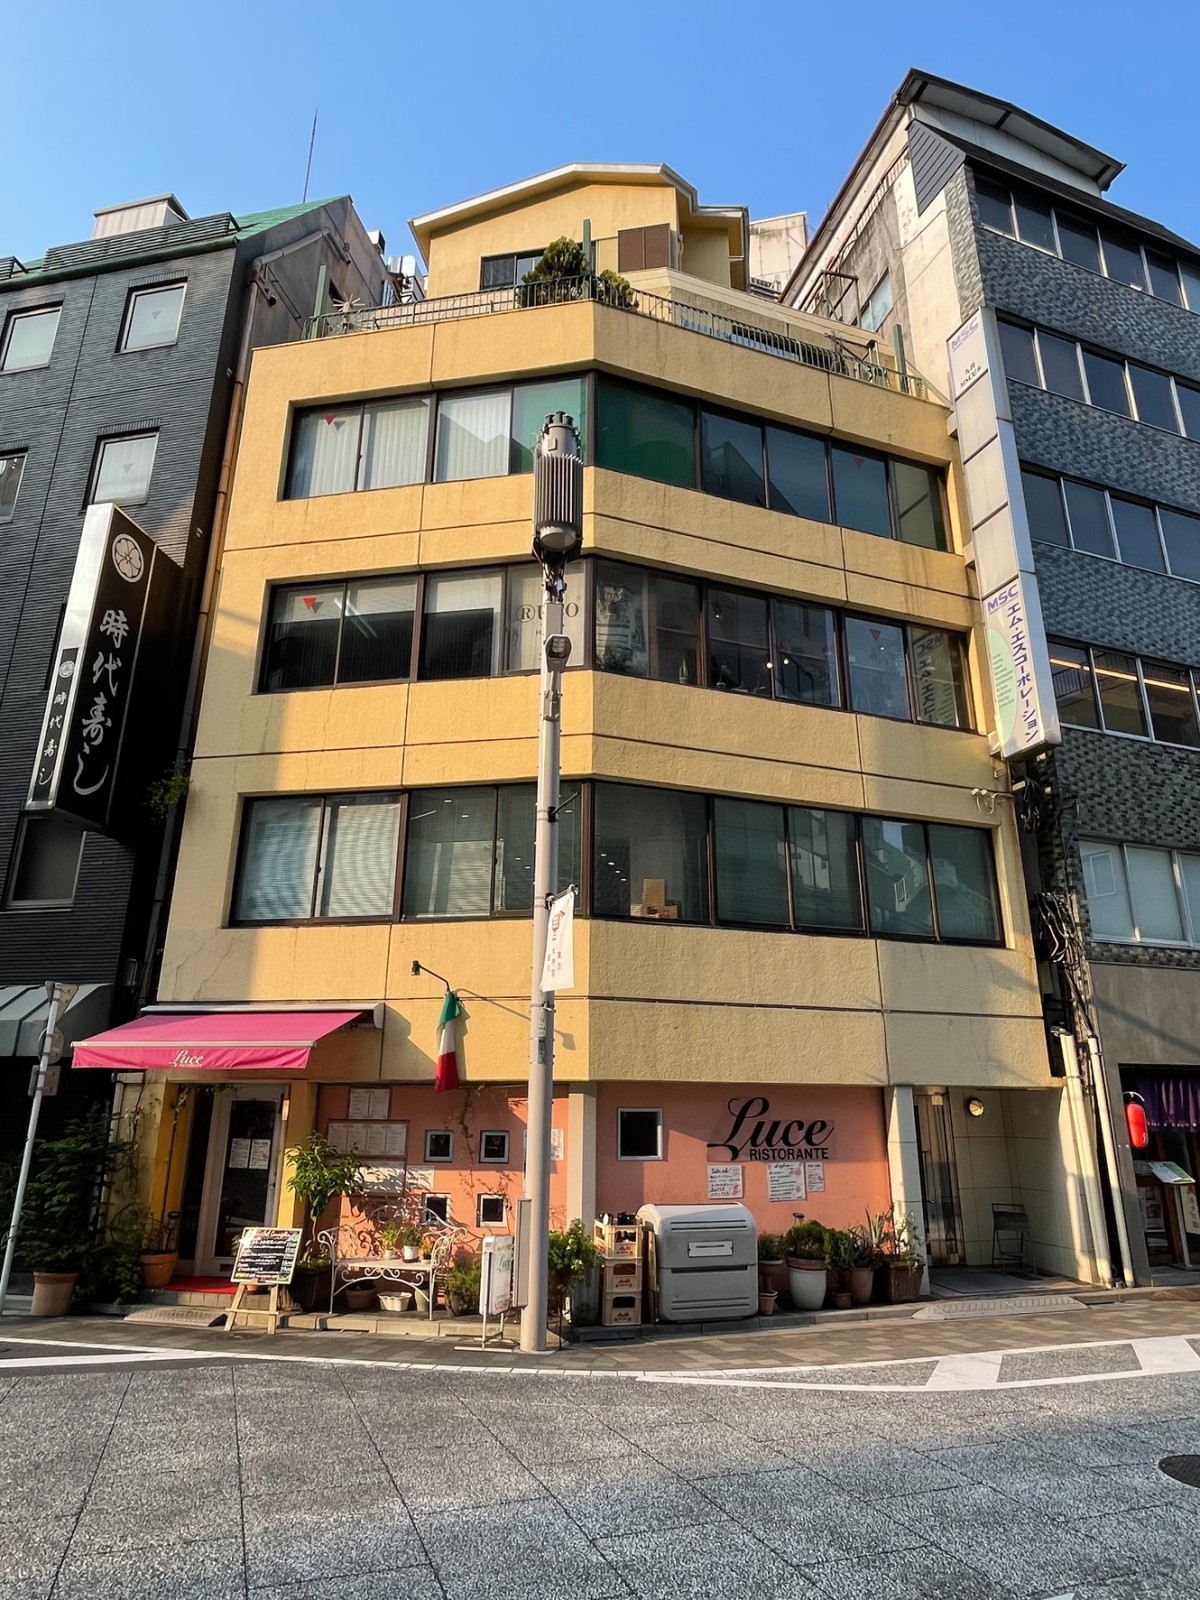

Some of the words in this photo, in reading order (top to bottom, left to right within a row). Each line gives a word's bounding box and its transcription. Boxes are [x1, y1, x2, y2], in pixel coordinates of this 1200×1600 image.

[951, 317, 979, 349] MSC
[987, 583, 1019, 613] MSC
[1007, 601, 1040, 743] エム・エスコーポレーション
[73, 609, 129, 796] 時代寿し
[37, 692, 68, 786] 時代寿し
[168, 1049, 204, 1068] Luce
[707, 1097, 834, 1161] Luce
[750, 1148, 829, 1161] RISTORANTE
